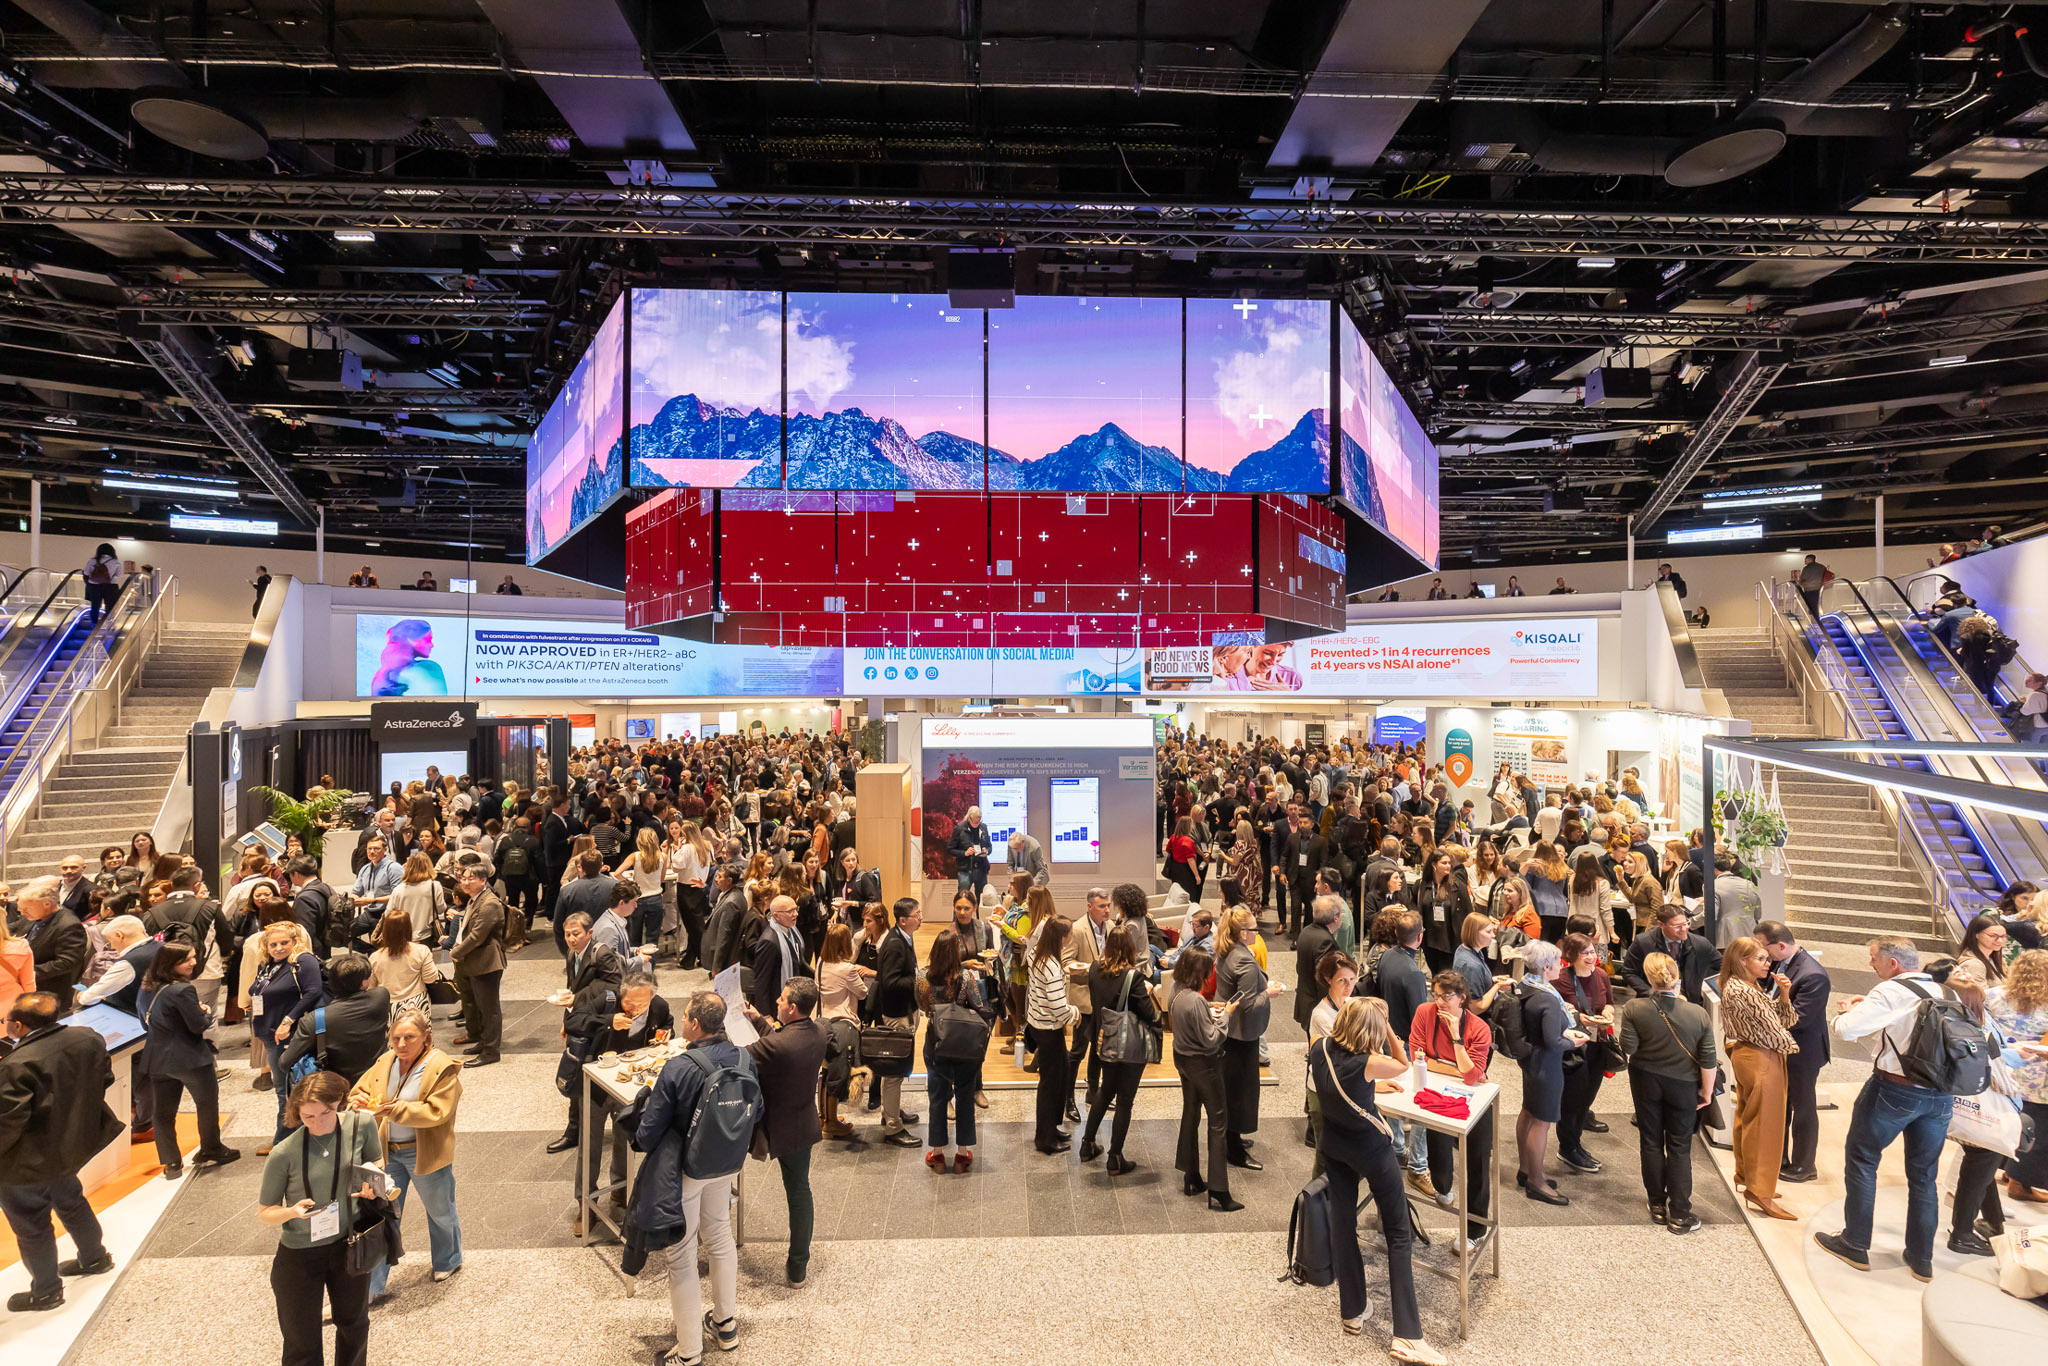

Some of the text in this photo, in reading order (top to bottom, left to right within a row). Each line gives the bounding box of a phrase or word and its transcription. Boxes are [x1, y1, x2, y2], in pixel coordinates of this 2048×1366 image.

[1362, 636, 1380, 645] EBC
[1525, 633, 1581, 644] KISQALI
[475, 644, 516, 656] NOW
[518, 645, 597, 657] APPROVED
[599, 648, 610, 657] in
[675, 649, 697, 659] aBC
[864, 647, 1075, 661] JOIN THE CONVERSATION ON SOCIAL MEDIA!
[1154, 650, 1209, 662] NO NEWS IS
[1311, 647, 1370, 658] Prevented
[1381, 647, 1386, 657] 1
[1388, 647, 1400, 657] in
[1401, 646, 1410, 657] 4
[1412, 647, 1491, 656] recurrences
[475, 660, 503, 670] with
[506, 659, 620, 671] PIK3CA/AKT1/PTEN
[1154, 661, 1210, 673] GOOD NEWS
[1311, 660, 1322, 670] at
[1323, 660, 1332, 670] 4
[1333, 662, 1366, 672] years
[1383, 659, 1414, 669] NSAI
[545, 677, 579, 685] possible
[384, 719, 451, 729] AstraZeneca
[1512, 725, 1549, 733] SHARING
[931, 722, 962, 740] Lilly
